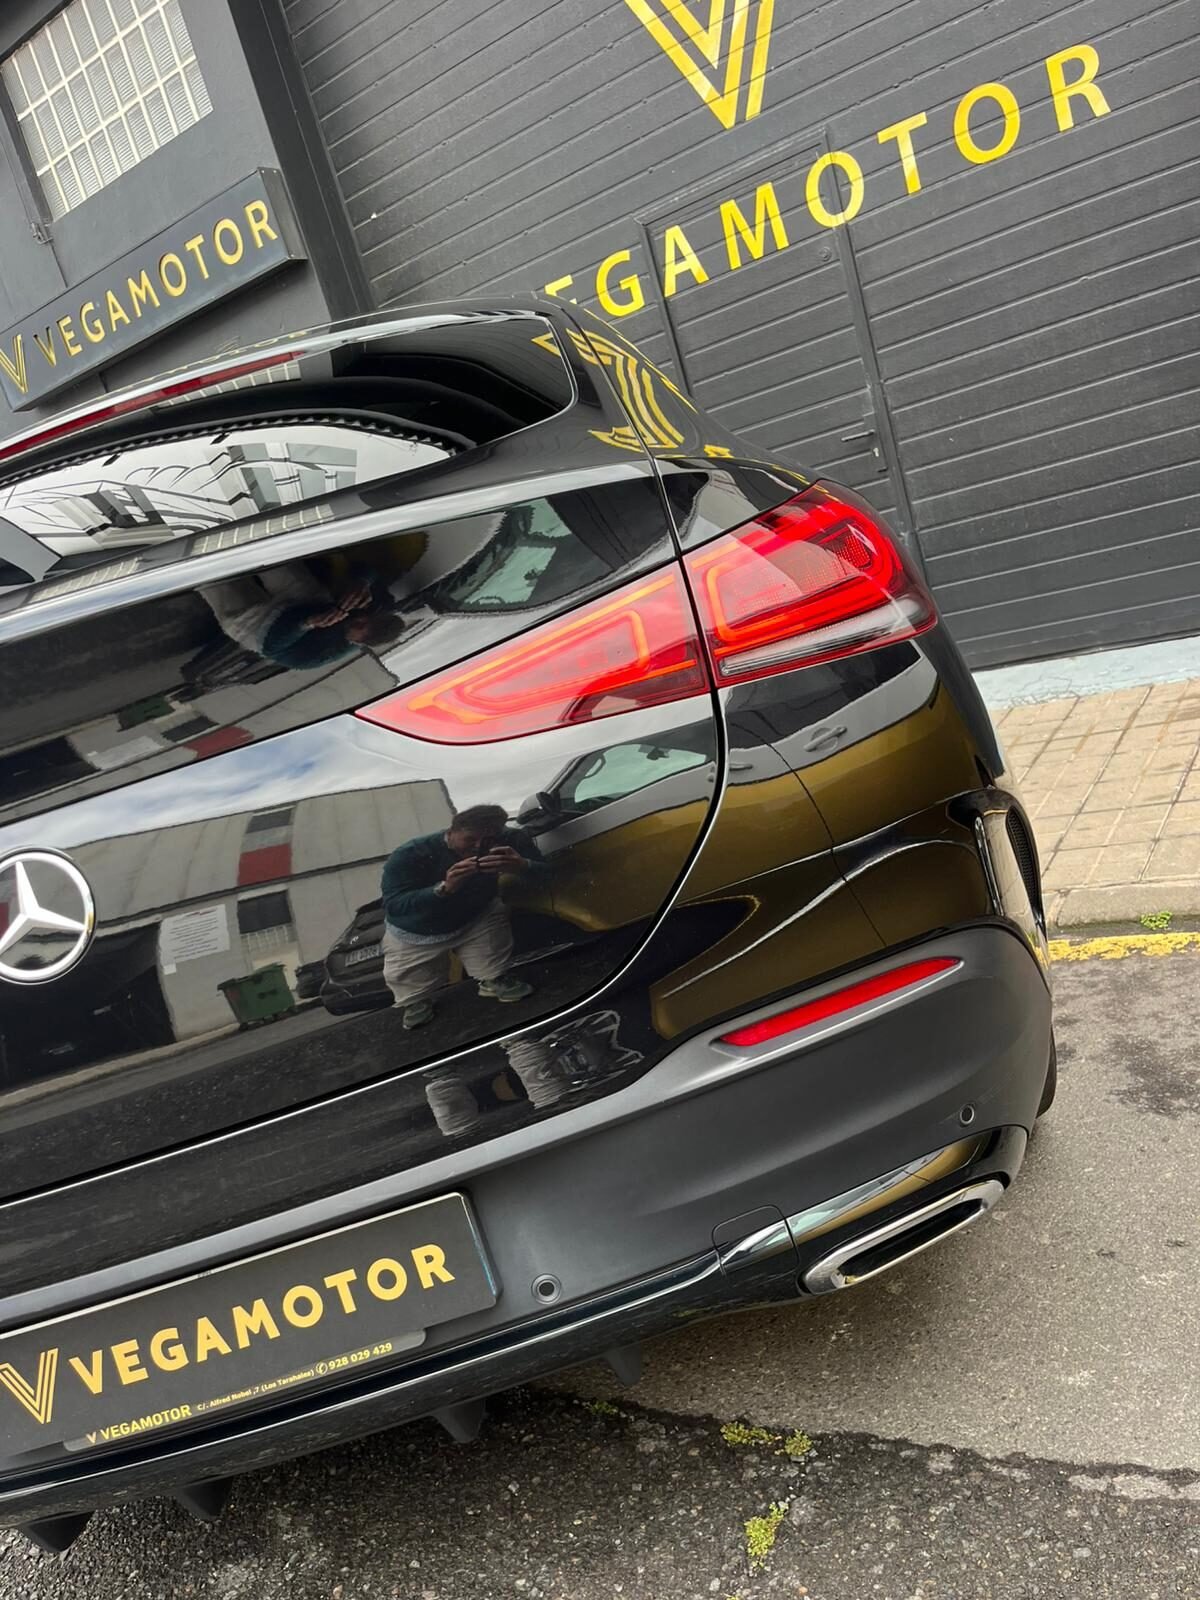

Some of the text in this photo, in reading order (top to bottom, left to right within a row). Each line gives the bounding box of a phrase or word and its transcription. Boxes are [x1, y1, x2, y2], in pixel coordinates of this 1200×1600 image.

[33, 200, 279, 367] VEGAMOTOR
[68, 1243, 456, 1395] VEGAMOTOR
[100, 1404, 192, 1440] VEGAMOTOR
[210, 1395, 232, 1408] Alfred
[328, 1356, 349, 1371] 928
[350, 1349, 371, 1364] 029
[372, 1342, 393, 1356] 429
